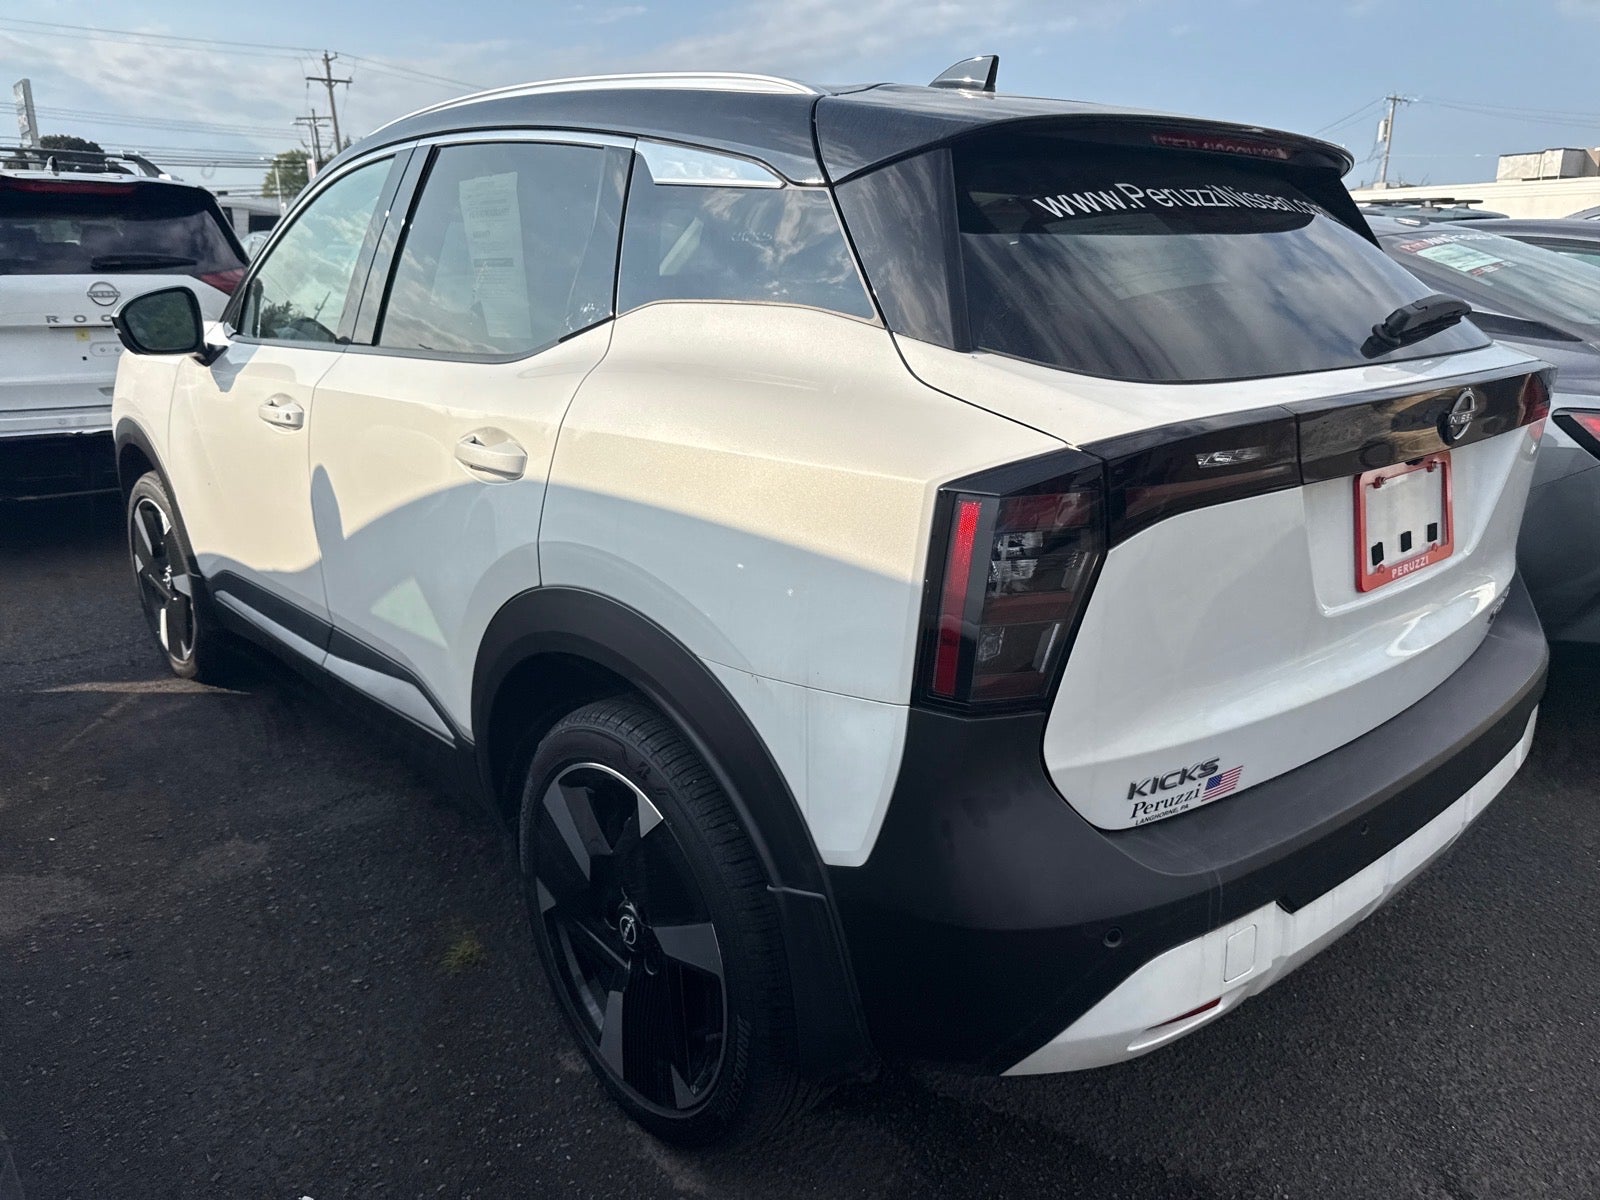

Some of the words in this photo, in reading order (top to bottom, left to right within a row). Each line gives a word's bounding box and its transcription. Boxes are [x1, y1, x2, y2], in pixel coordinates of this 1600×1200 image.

[45, 314, 112, 323] ROG
[1391, 555, 1429, 578] PERUZZI
[1126, 758, 1220, 800] KICKS
[1130, 783, 1202, 819] Peruzzi
